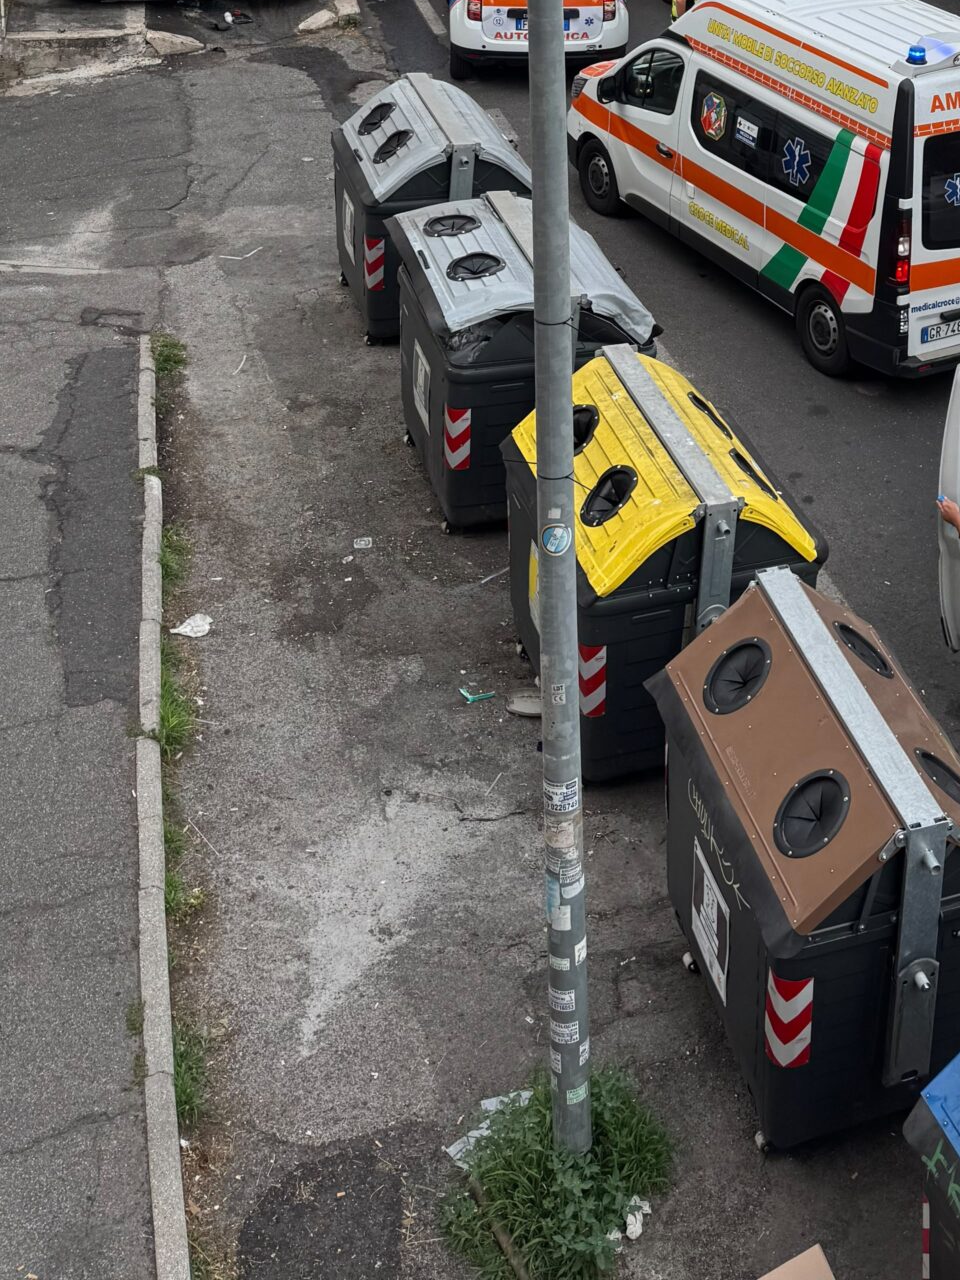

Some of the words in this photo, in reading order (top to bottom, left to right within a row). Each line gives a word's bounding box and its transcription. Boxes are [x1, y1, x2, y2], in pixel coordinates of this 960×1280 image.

[494, 32, 590, 40] AUTOICA
[733, 30, 765, 58] MOBILE
[763, 45, 775, 64] DI
[774, 51, 826, 88] SOCCORSO
[825, 77, 879, 114] AVANZATO
[688, 201, 714, 228] CROCE
[715, 217, 750, 251] MEDICAL
